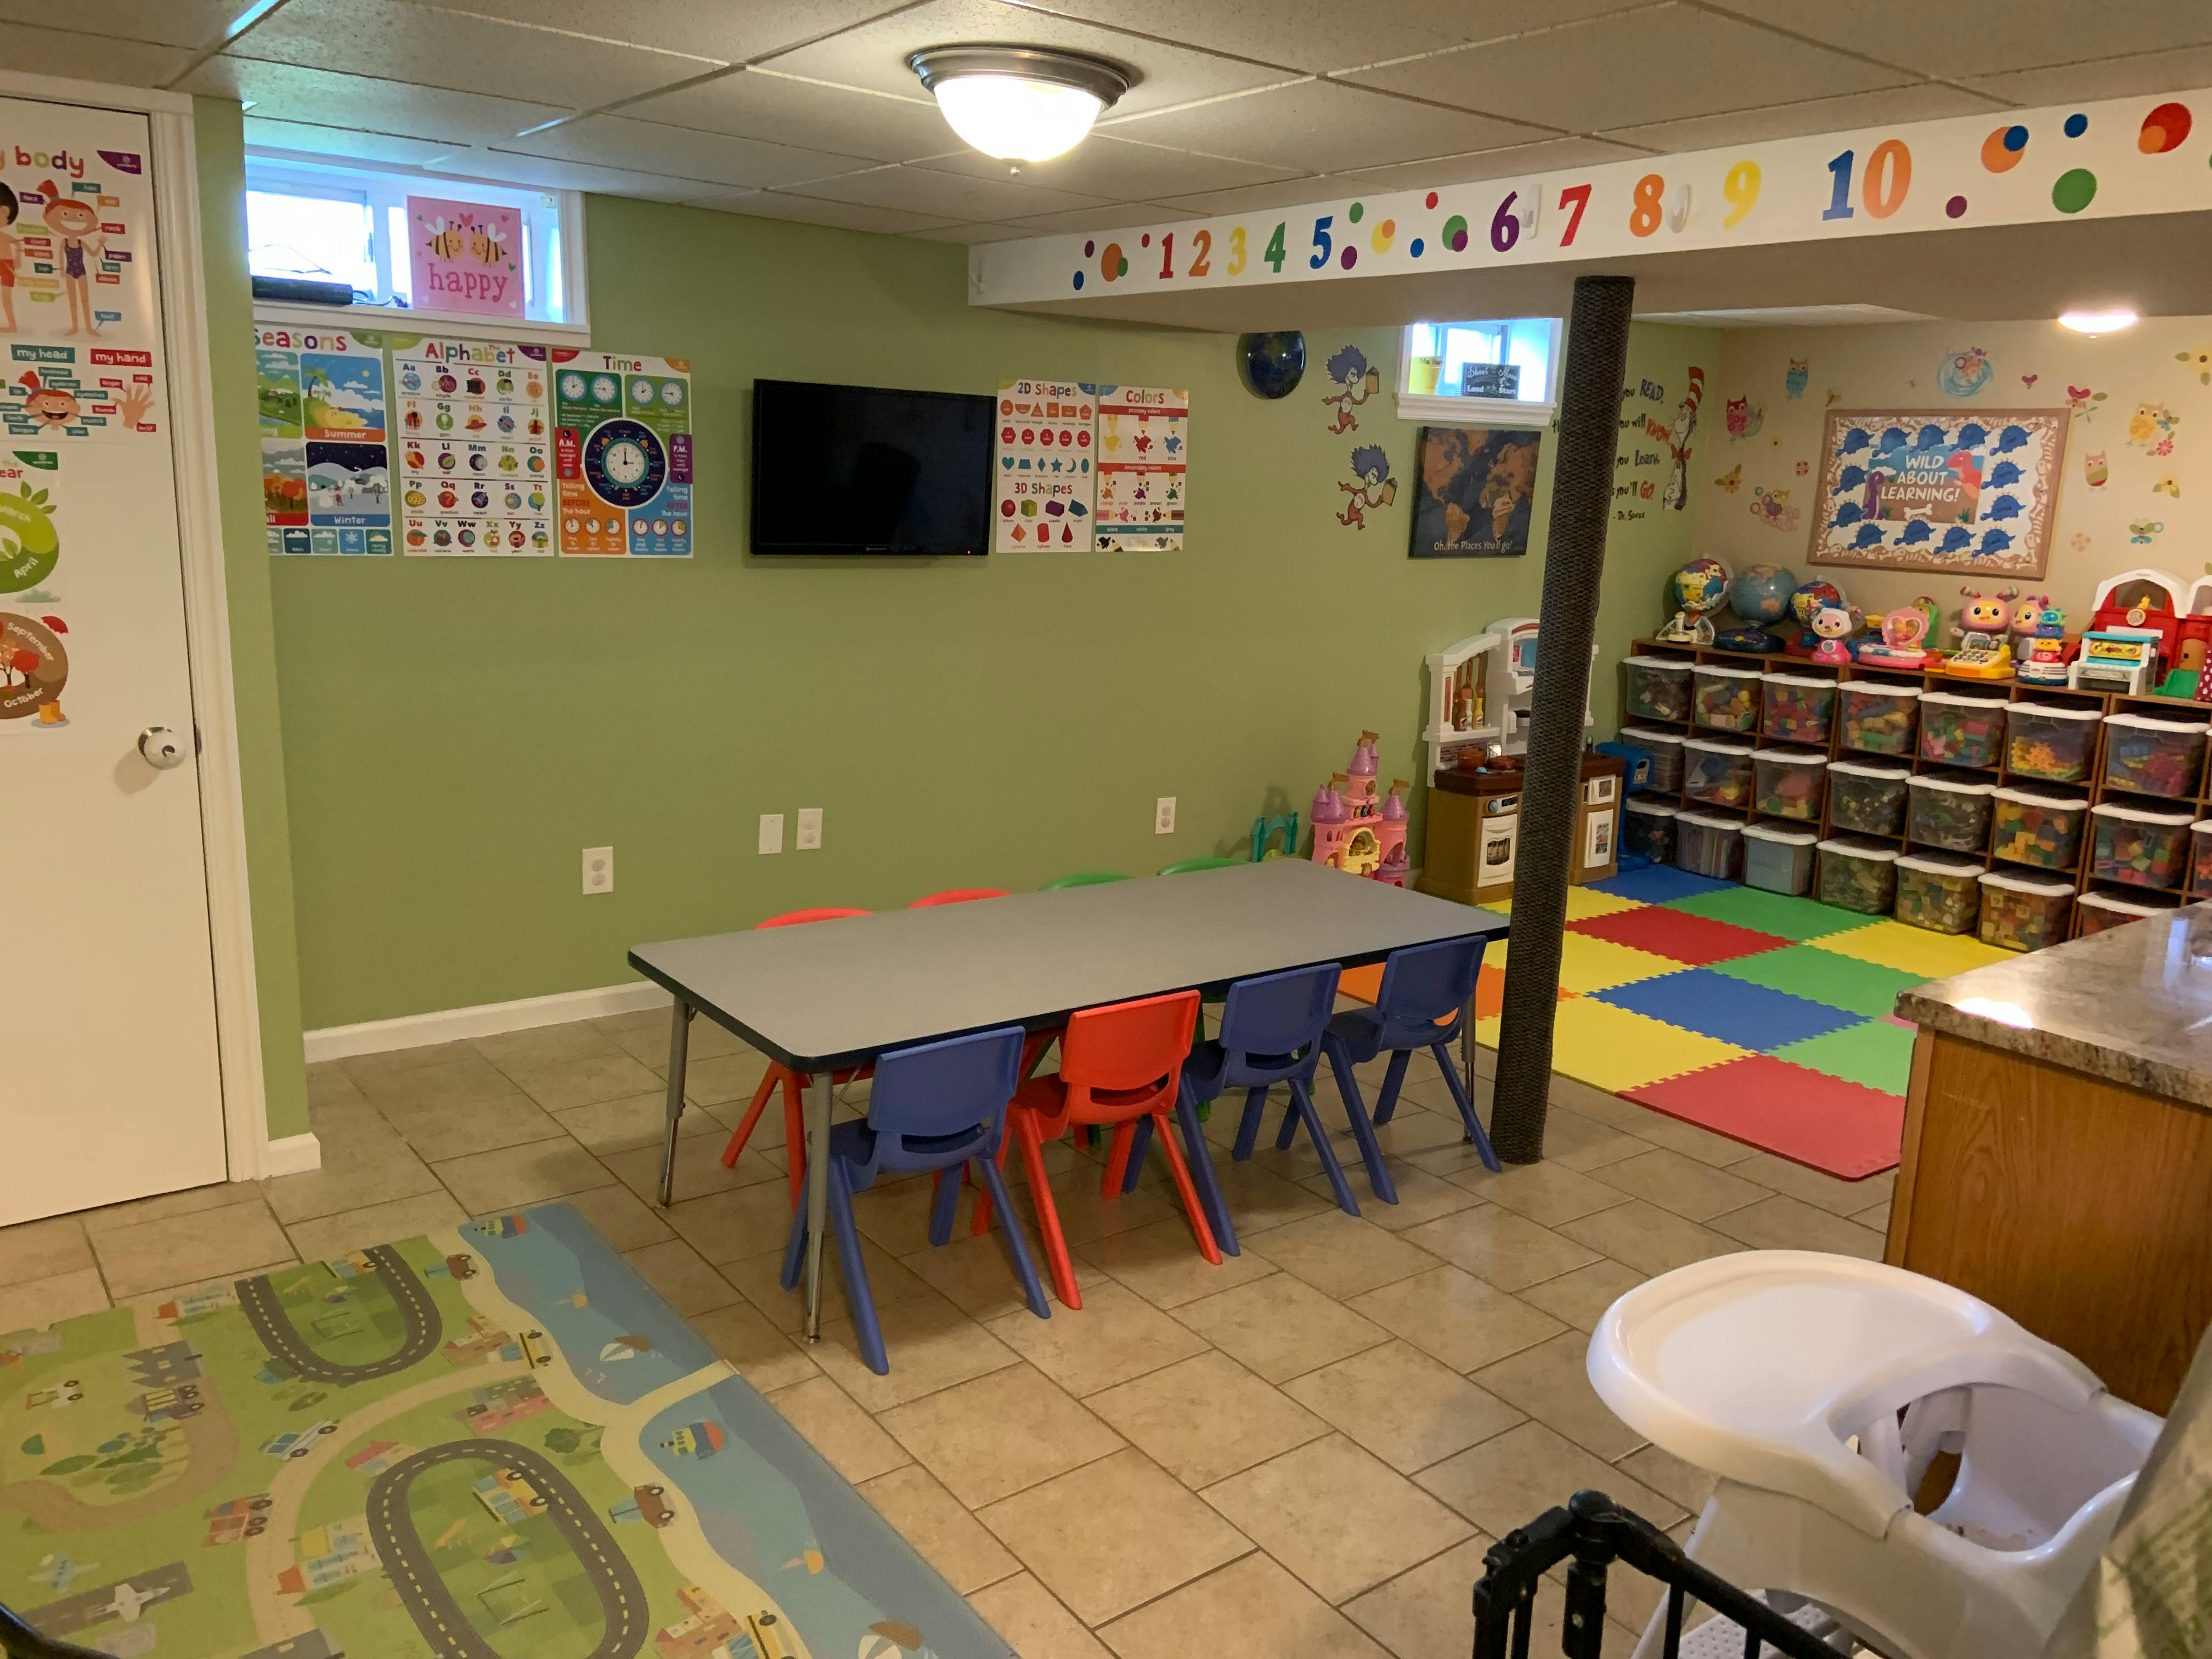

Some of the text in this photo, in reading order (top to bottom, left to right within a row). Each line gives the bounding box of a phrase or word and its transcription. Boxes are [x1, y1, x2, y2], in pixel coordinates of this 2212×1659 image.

[15, 145, 84, 178] body
[1822, 139, 1912, 221] 10
[1723, 160, 1762, 228] 9
[1629, 174, 1664, 238] 8
[1491, 191, 1520, 252] 6
[1557, 184, 1592, 247] 7
[1265, 222, 1286, 273] 4
[1310, 216, 1334, 269] 5
[1159, 233, 1173, 279] 1
[1189, 230, 1212, 277] 2
[1227, 227, 1246, 276] 3
[427, 263, 509, 302] happy
[17, 349, 67, 360] my head
[95, 353, 146, 363] my hand
[425, 342, 515, 364] Alphabet
[603, 356, 642, 371] Time
[1018, 382, 1077, 399] 2D Shapes
[1126, 389, 1164, 404] Colors
[1622, 388, 1635, 401] you
[437, 403, 450, 412] Gg
[531, 408, 539, 417] Jj
[1620, 420, 1629, 428] ou
[1632, 413, 1645, 428] will
[325, 430, 366, 439] Summer
[1616, 456, 1629, 469] you
[1905, 454, 1944, 470] WILD
[0, 469, 23, 478] ear
[1897, 470, 1948, 484] ABOUT
[409, 481, 422, 489] Pp
[441, 481, 455, 490] Qq
[1015, 482, 1073, 496] 3D Shapes
[1881, 487, 1960, 503] LEARNING!
[334, 516, 365, 524] Winter
[1628, 510, 1645, 521] Seuss
[1447, 540, 1458, 550] the
[1461, 540, 1481, 550] Places
[14, 557, 38, 578] April
[7, 622, 54, 661] September
[4, 688, 43, 707] October
